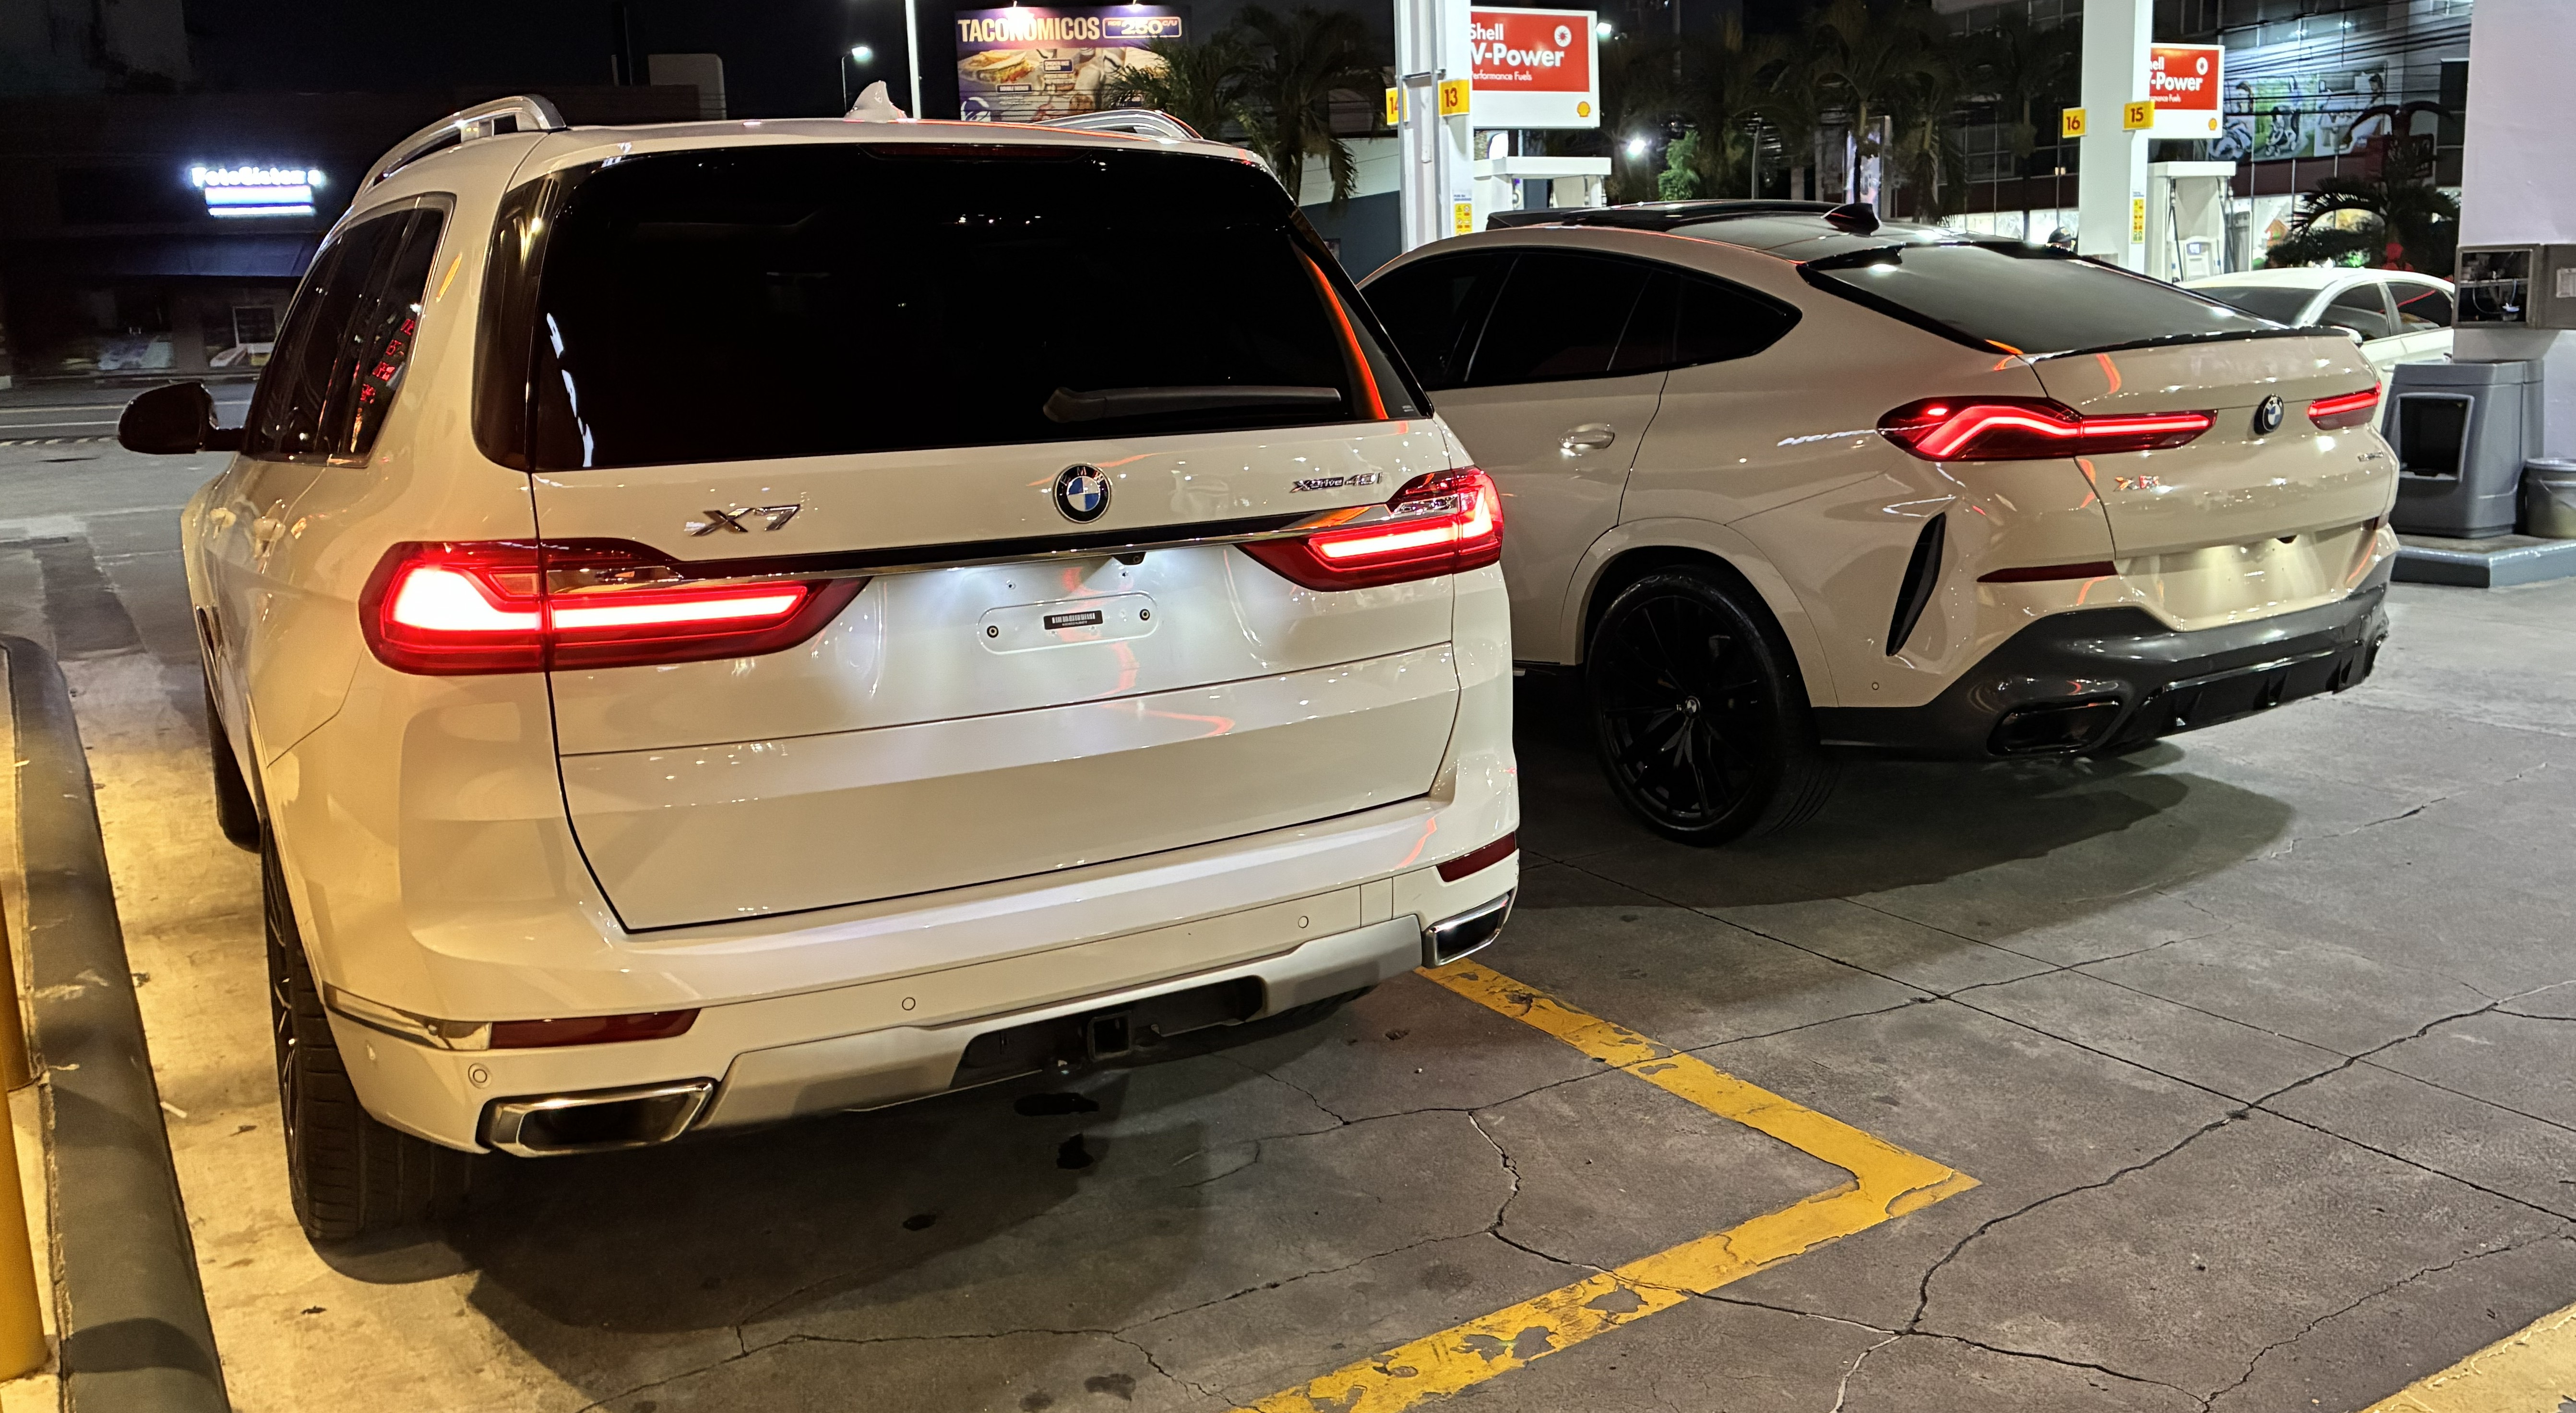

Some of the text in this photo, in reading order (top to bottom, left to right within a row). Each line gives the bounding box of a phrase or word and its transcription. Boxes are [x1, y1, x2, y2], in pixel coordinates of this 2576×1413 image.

[1121, 19, 1163, 35] 250
[1470, 23, 1504, 40] Shell
[1470, 42, 1564, 67] V-Power
[2150, 56, 2165, 70] ell
[1473, 69, 1532, 81] erformance Fuels
[1444, 87, 1458, 107] 13
[2066, 115, 2080, 130] 16
[2131, 107, 2144, 123] 15
[1060, 466, 1104, 486] BMW
[690, 503, 800, 537] X7
